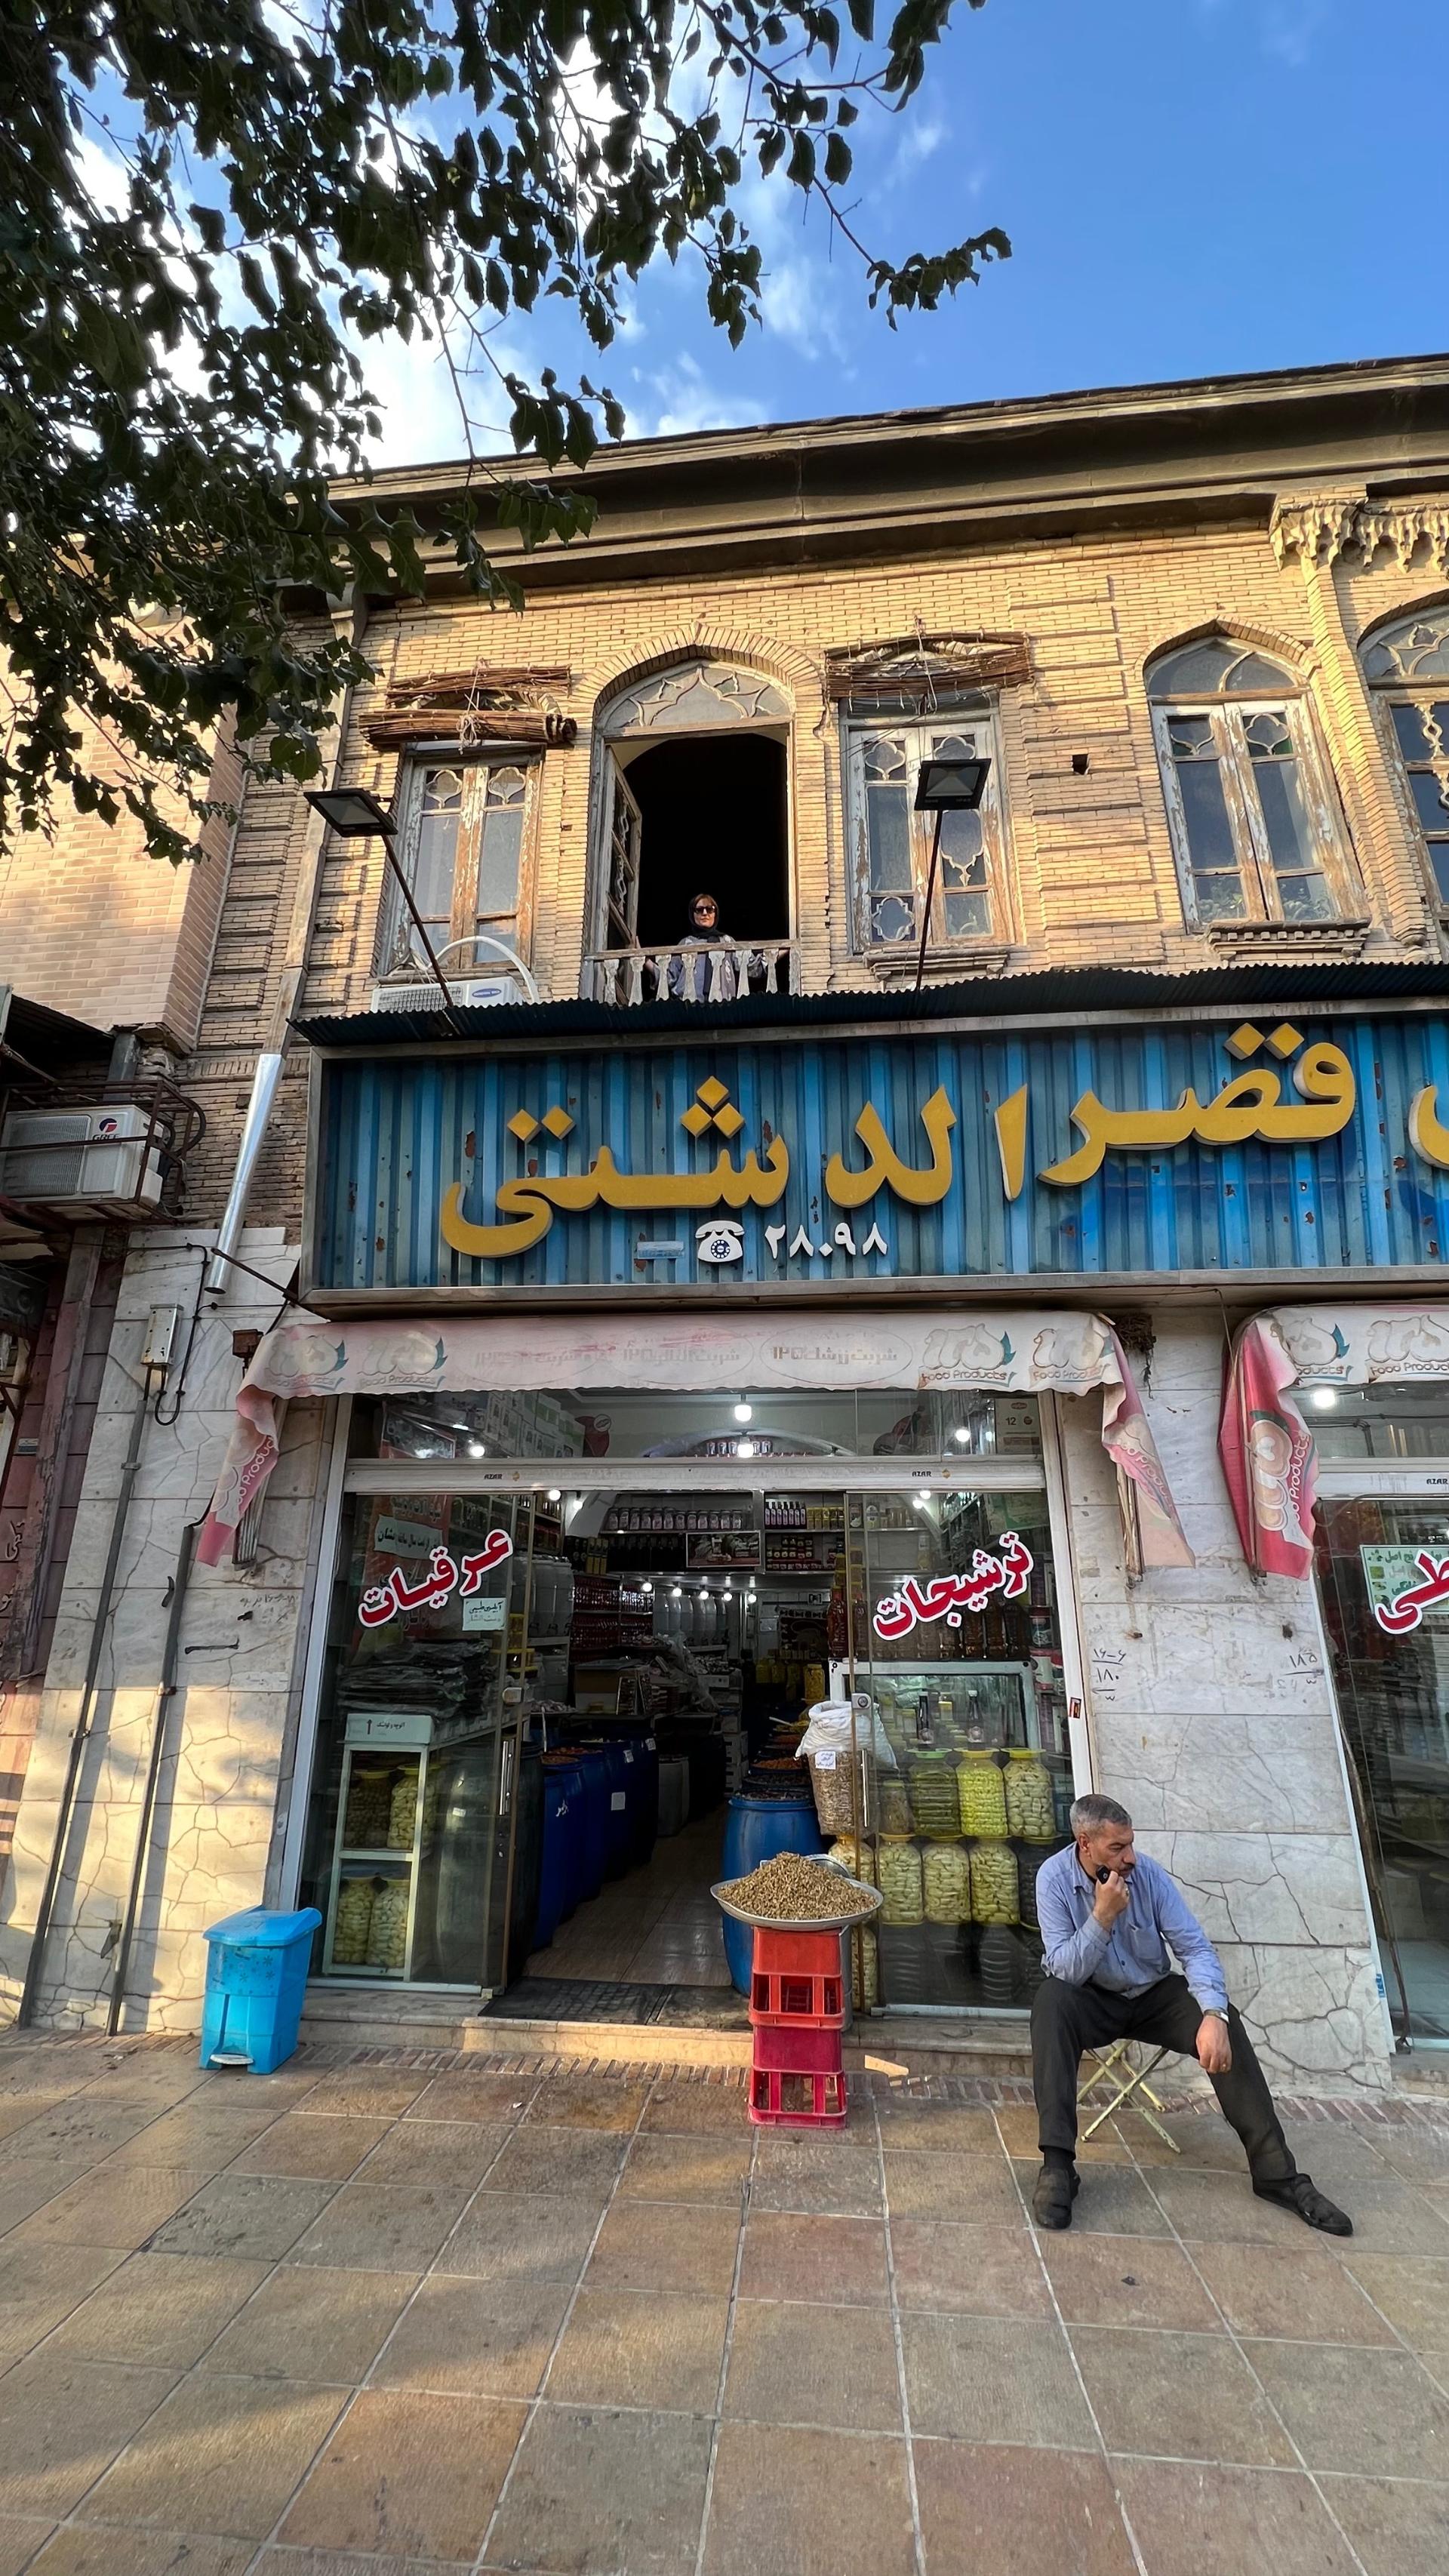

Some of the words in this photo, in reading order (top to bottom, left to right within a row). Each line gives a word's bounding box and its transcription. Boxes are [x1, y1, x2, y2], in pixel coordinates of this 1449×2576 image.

[1037, 1022, 1356, 1187] قصر
[441, 1076, 1028, 1258] الدشتی
[921, 1373, 951, 1382] Food
[952, 1370, 1008, 1381] Products
[1033, 1370, 1062, 1380] Food
[1297, 1365, 1345, 1375] oducts
[1371, 1365, 1401, 1376] Food
[1404, 1362, 1449, 1373] Produc
[389, 1374, 436, 1384] Products
[1005, 1417, 1017, 1426] 12
[1289, 1433, 1311, 1499] Products
[359, 1530, 513, 1627] عرقیات
[873, 1531, 1034, 1640] ترشیجات
